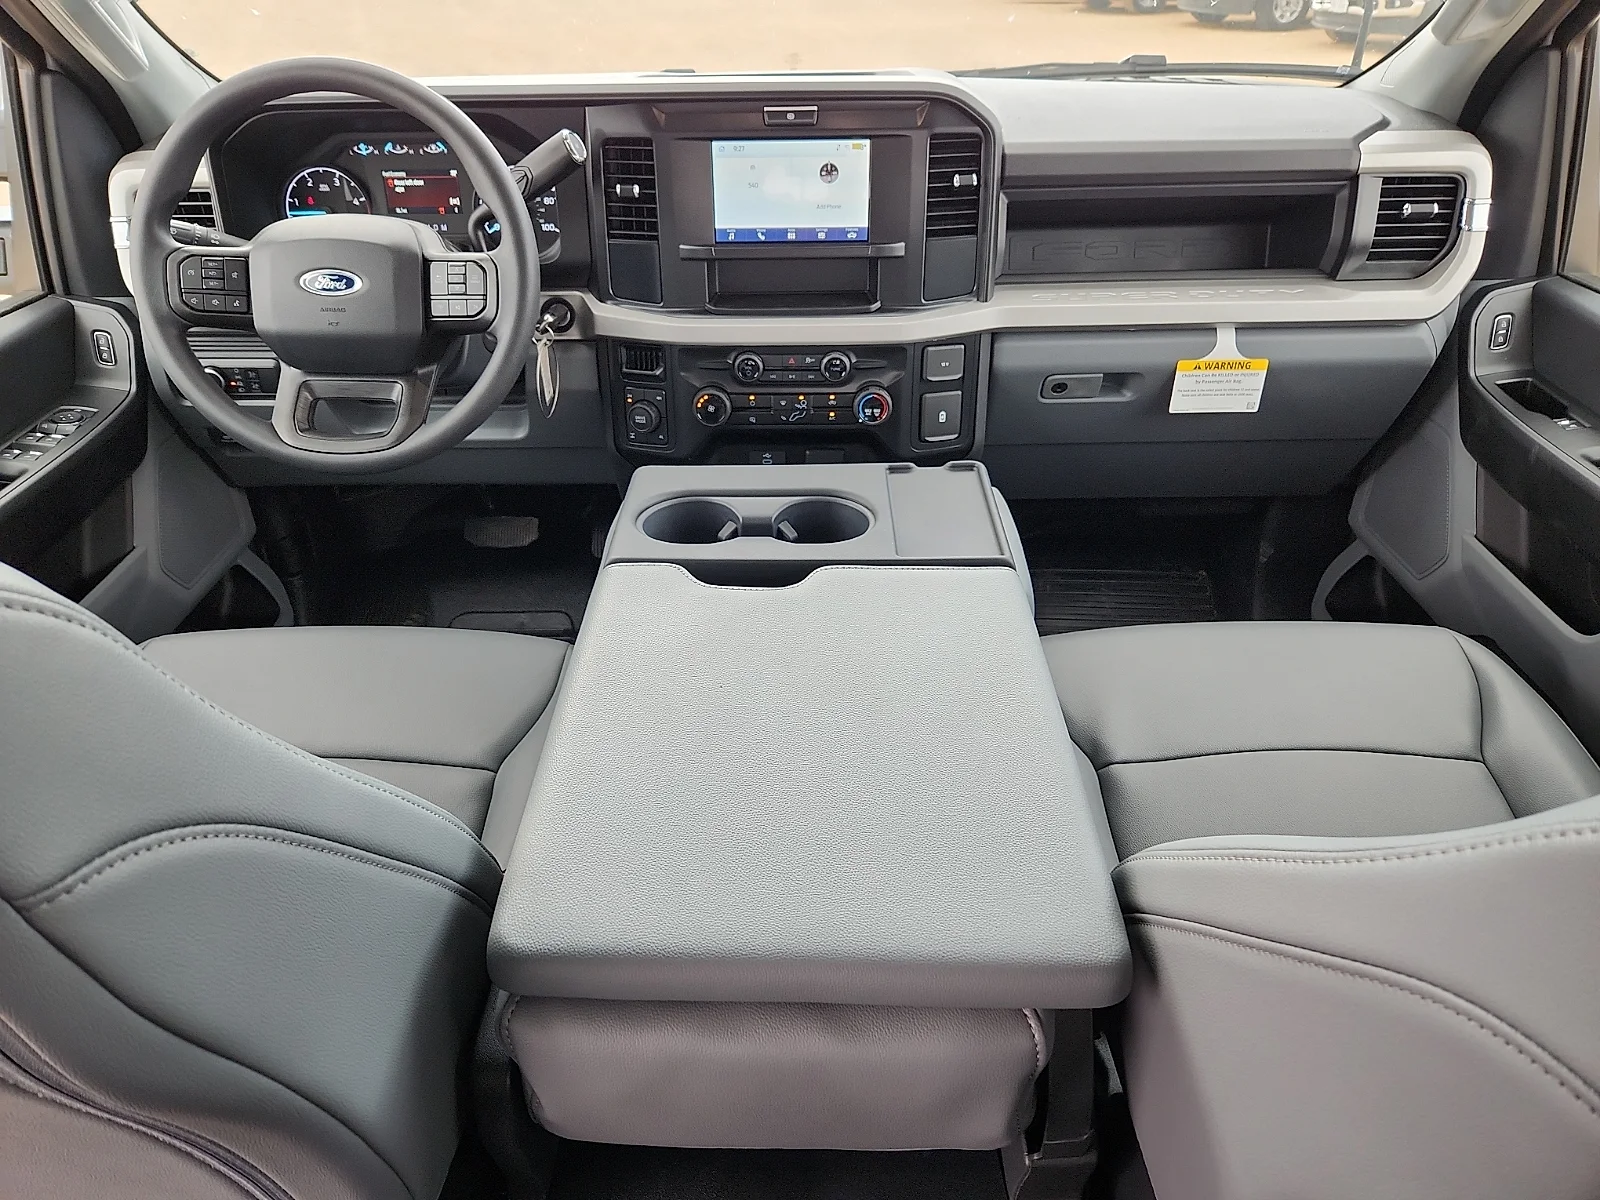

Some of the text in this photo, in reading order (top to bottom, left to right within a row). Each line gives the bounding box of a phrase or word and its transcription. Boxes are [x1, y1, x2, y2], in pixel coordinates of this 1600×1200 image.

[307, 178, 314, 187] 2
[333, 178, 341, 187] 3
[293, 198, 300, 207] 1
[352, 197, 360, 206] 4
[543, 197, 555, 205] 80
[541, 223, 555, 232] 100
[1032, 238, 1232, 262] FORD
[314, 274, 347, 290] Ford
[1031, 288, 1305, 301] SUPER DUTY
[1204, 361, 1252, 370] WARNING
